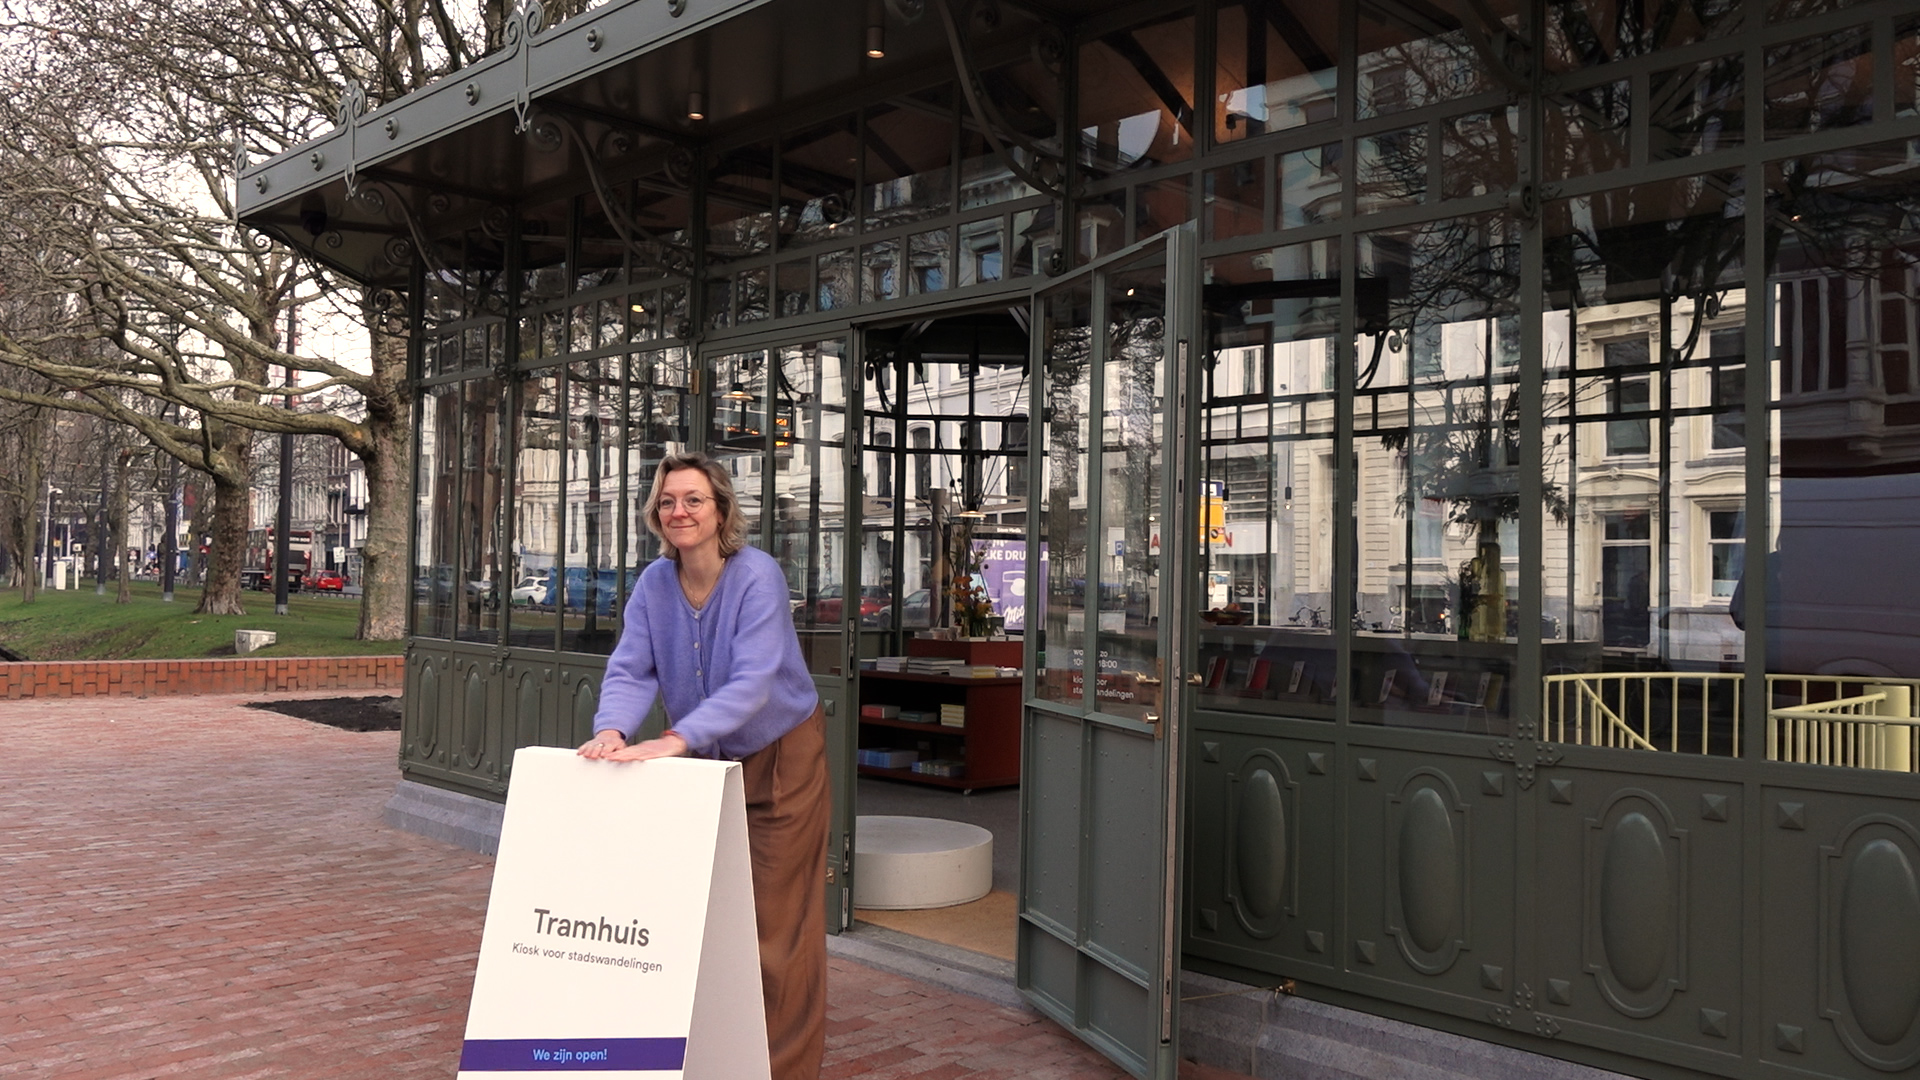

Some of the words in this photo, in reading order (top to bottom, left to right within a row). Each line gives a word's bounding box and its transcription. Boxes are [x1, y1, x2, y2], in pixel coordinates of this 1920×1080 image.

[534, 908, 650, 947] Tramhuis
[512, 942, 540, 957] Kiosk
[543, 949, 566, 959] voor
[568, 951, 663, 973] stadswandelingen
[532, 1048, 550, 1061] We
[552, 1048, 573, 1064] zijn
[575, 1048, 608, 1063] open!
